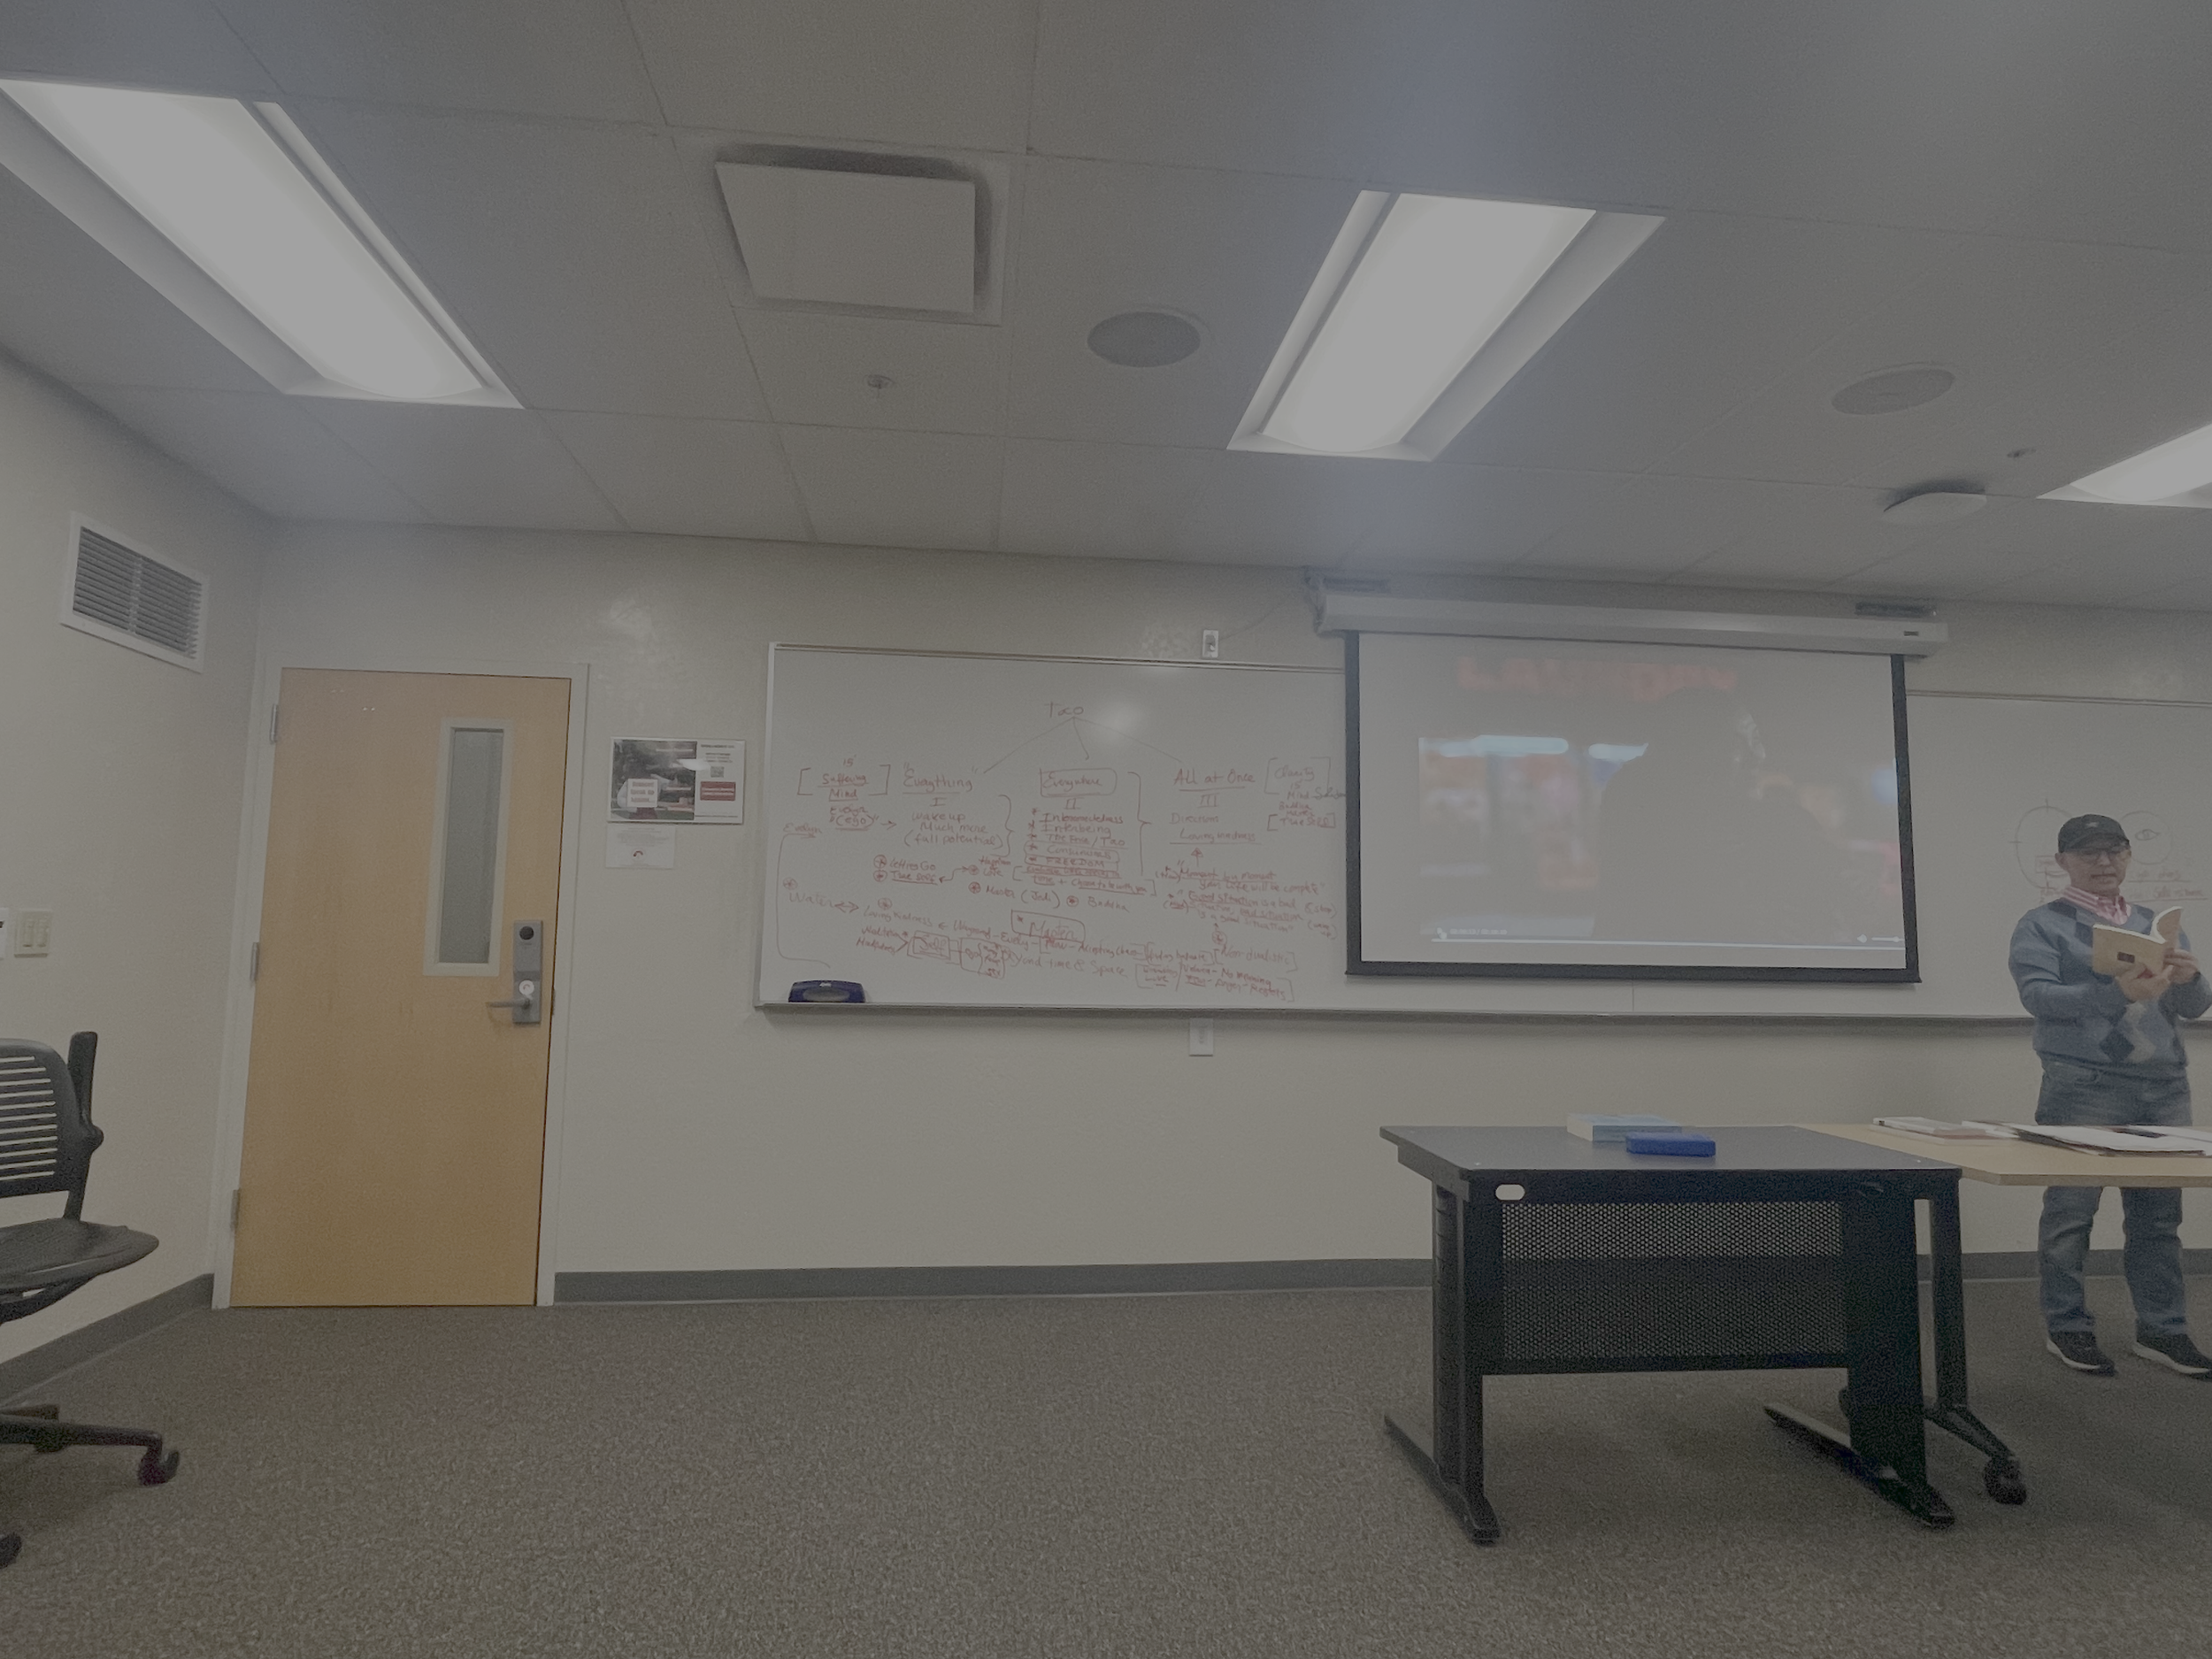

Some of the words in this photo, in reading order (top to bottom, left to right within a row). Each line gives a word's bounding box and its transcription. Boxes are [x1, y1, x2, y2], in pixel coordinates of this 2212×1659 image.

[822, 772, 868, 787] Suffering
[1203, 771, 1225, 784] at
[1226, 768, 1256, 783] Once
[949, 813, 966, 825] up
[920, 861, 936, 871] Go
[1046, 856, 1105, 869] FREEDOM
